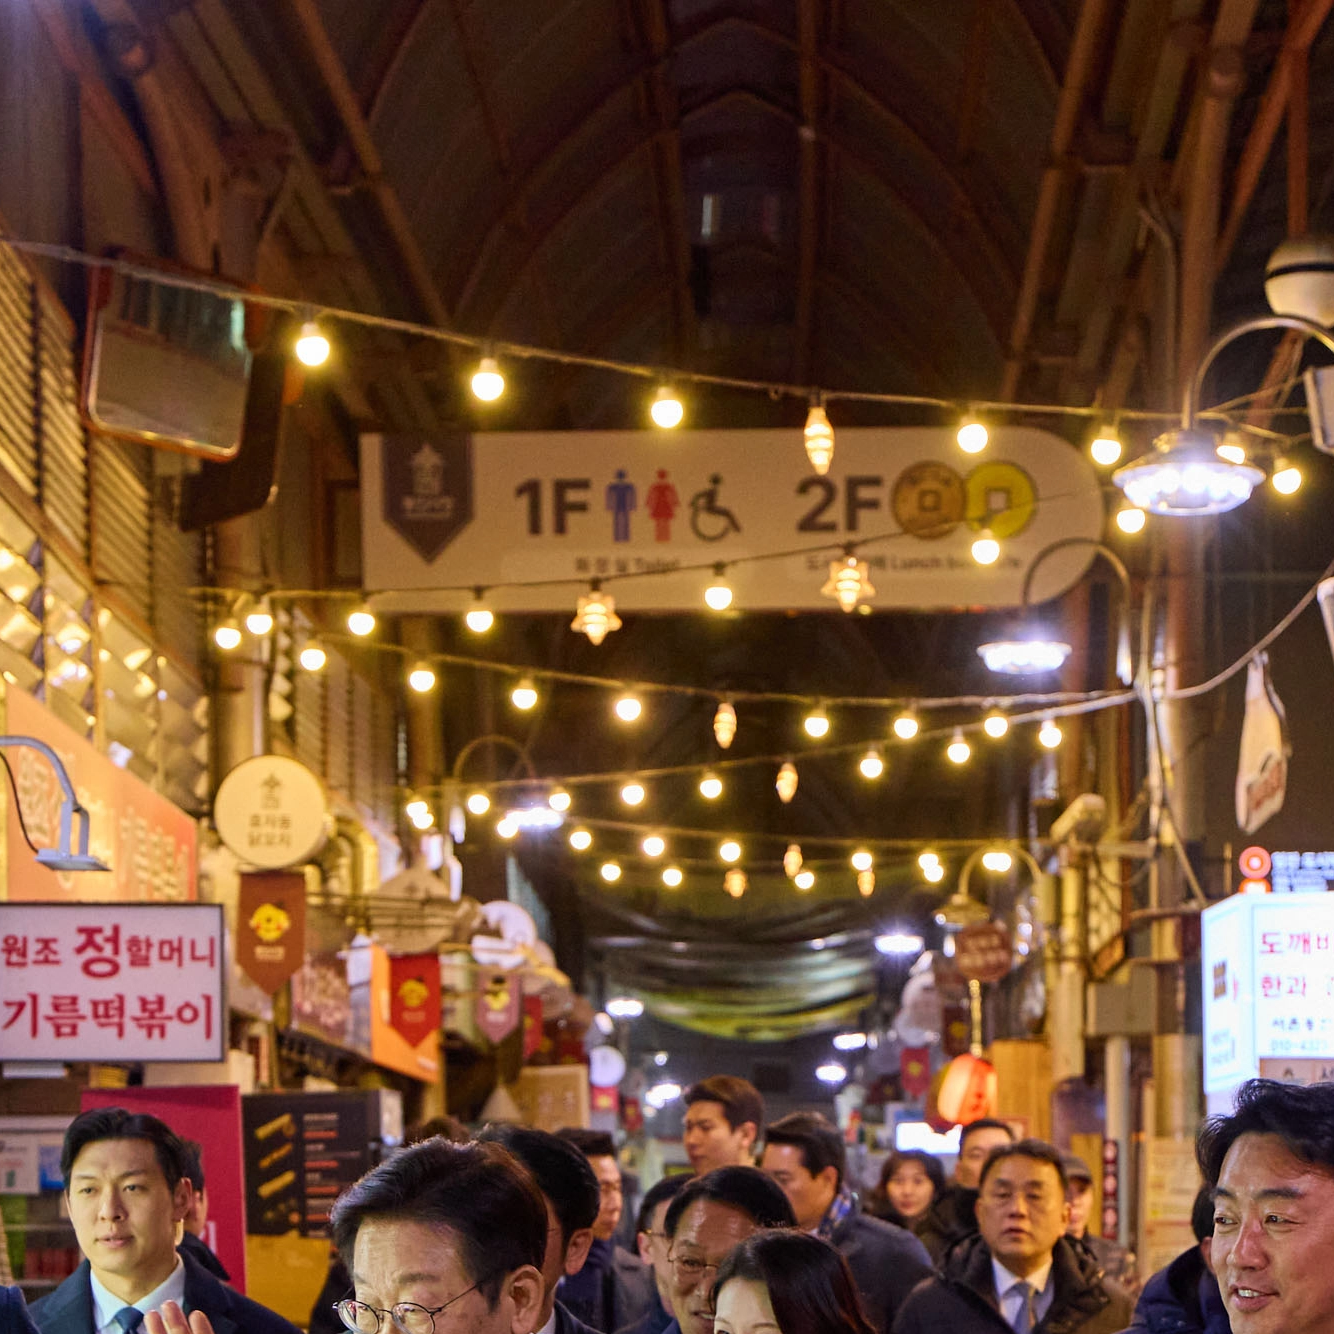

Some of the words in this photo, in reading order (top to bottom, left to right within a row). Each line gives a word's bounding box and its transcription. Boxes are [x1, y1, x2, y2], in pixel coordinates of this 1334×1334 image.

[515, 478, 591, 536] 1F
[796, 475, 884, 532] 2F
[1, 934, 62, 968] 원조
[1, 992, 213, 1041] 기름떡볶이
